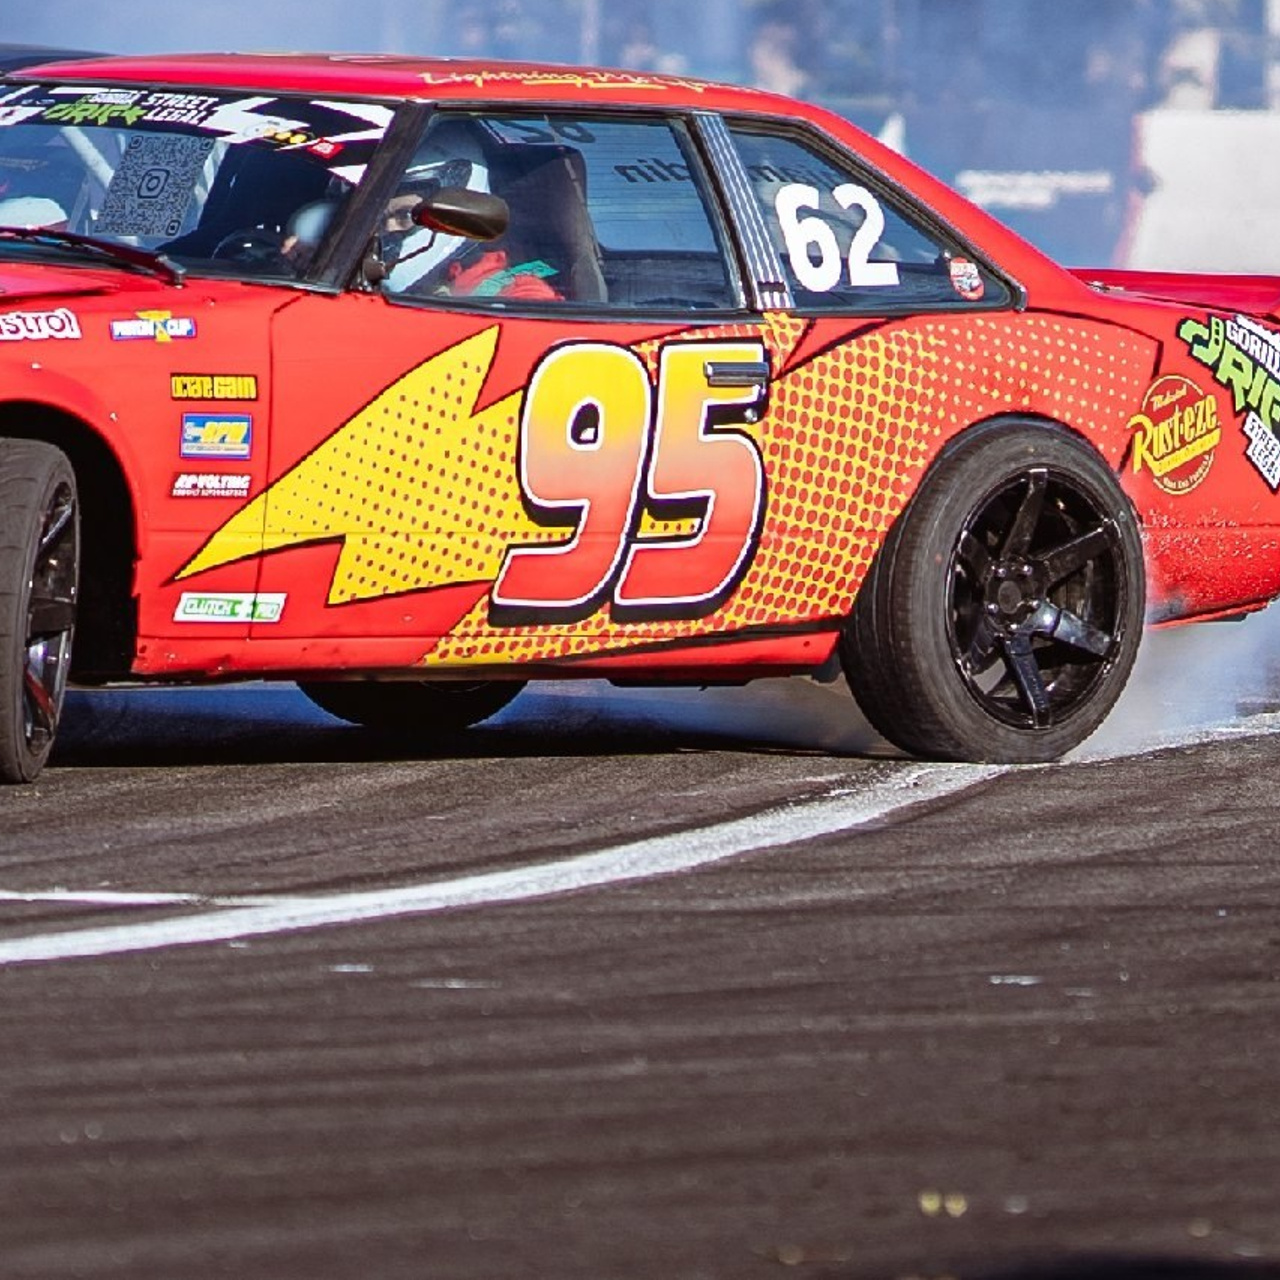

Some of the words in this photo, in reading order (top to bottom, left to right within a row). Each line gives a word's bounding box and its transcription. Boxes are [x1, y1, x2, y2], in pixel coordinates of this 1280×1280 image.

[141, 93, 219, 111] STREET
[142, 106, 207, 125] LEGAL
[775, 183, 900, 293] 62
[490, 339, 768, 620] 95
